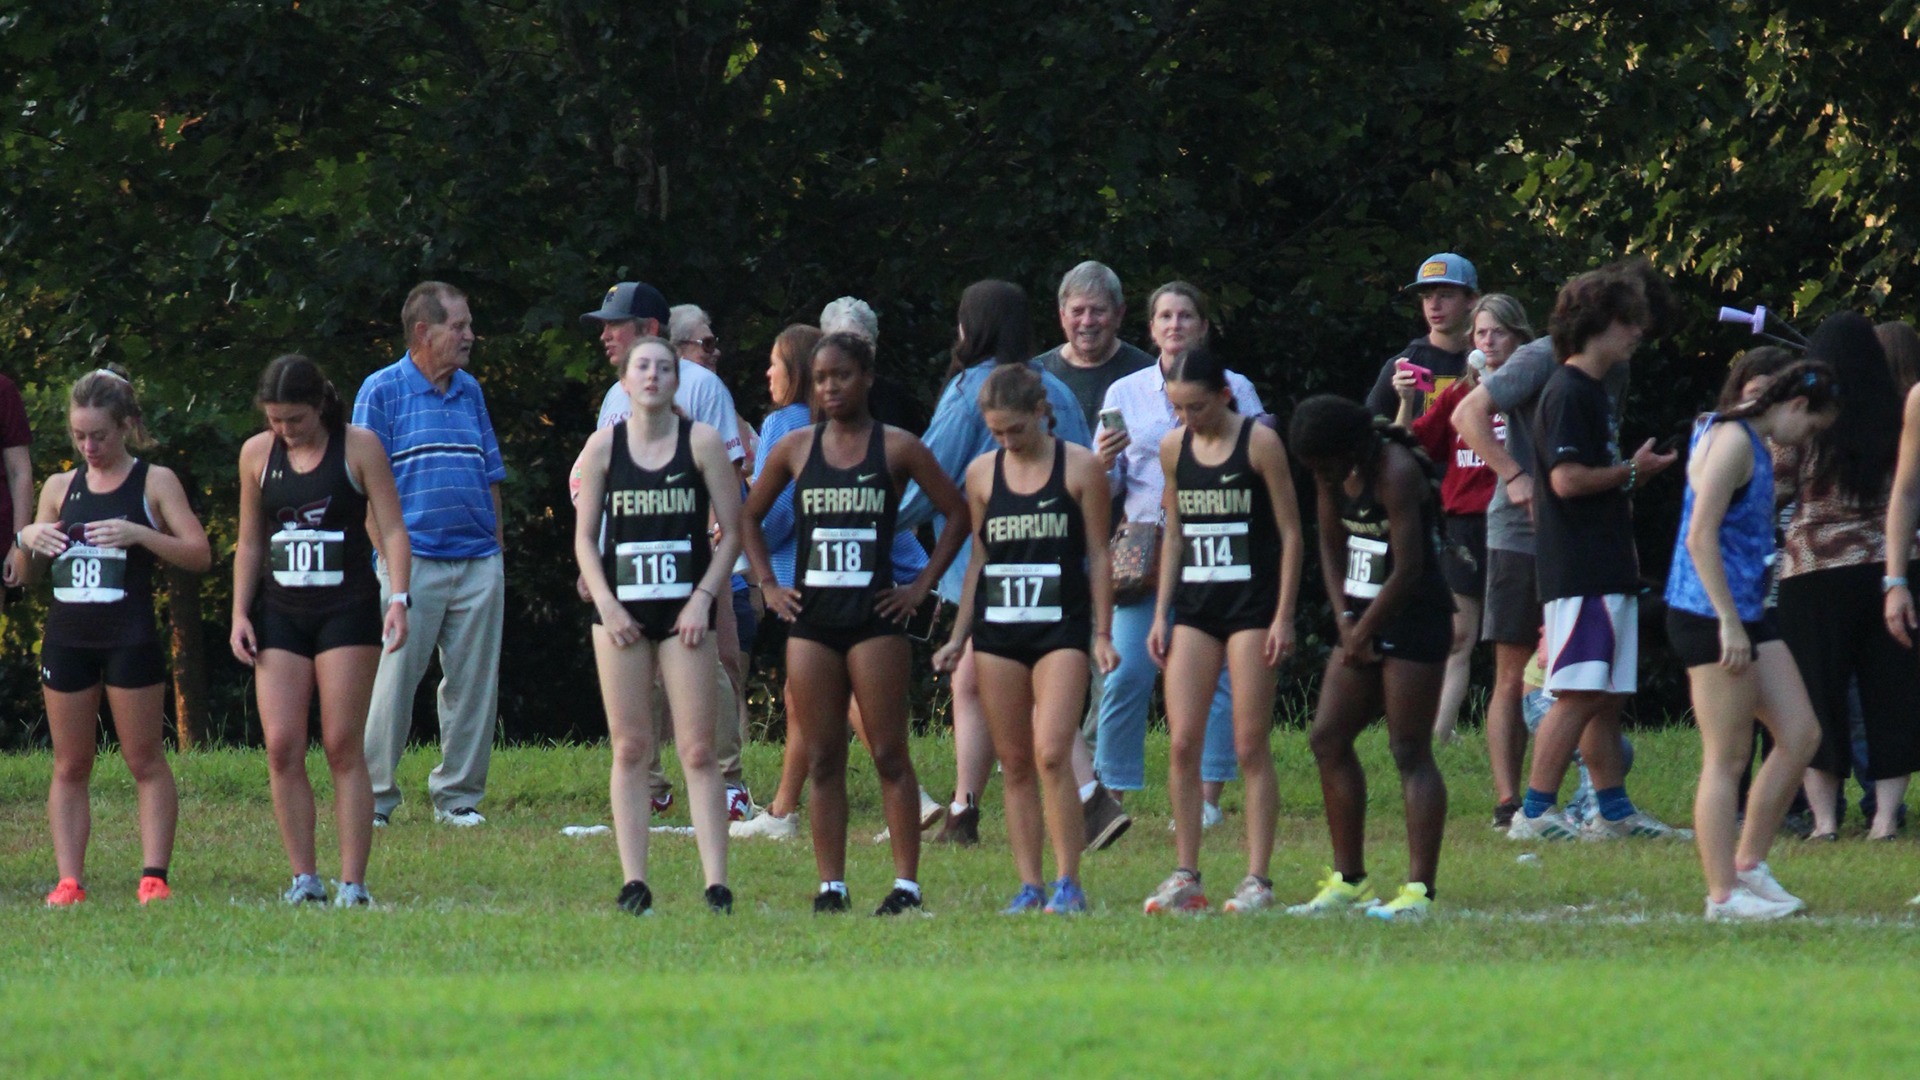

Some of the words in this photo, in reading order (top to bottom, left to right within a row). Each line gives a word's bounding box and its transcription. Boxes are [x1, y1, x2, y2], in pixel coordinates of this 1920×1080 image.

[612, 488, 696, 516] FERRUM
[802, 487, 886, 514] FERRUM
[1178, 489, 1252, 514] FERRUM
[987, 513, 1068, 542] FERRUM
[284, 541, 325, 571] 101
[817, 541, 861, 571] 118
[1192, 536, 1233, 566] 114
[71, 558, 101, 588] 98
[631, 553, 677, 584] 116
[1001, 577, 1043, 607] 117
